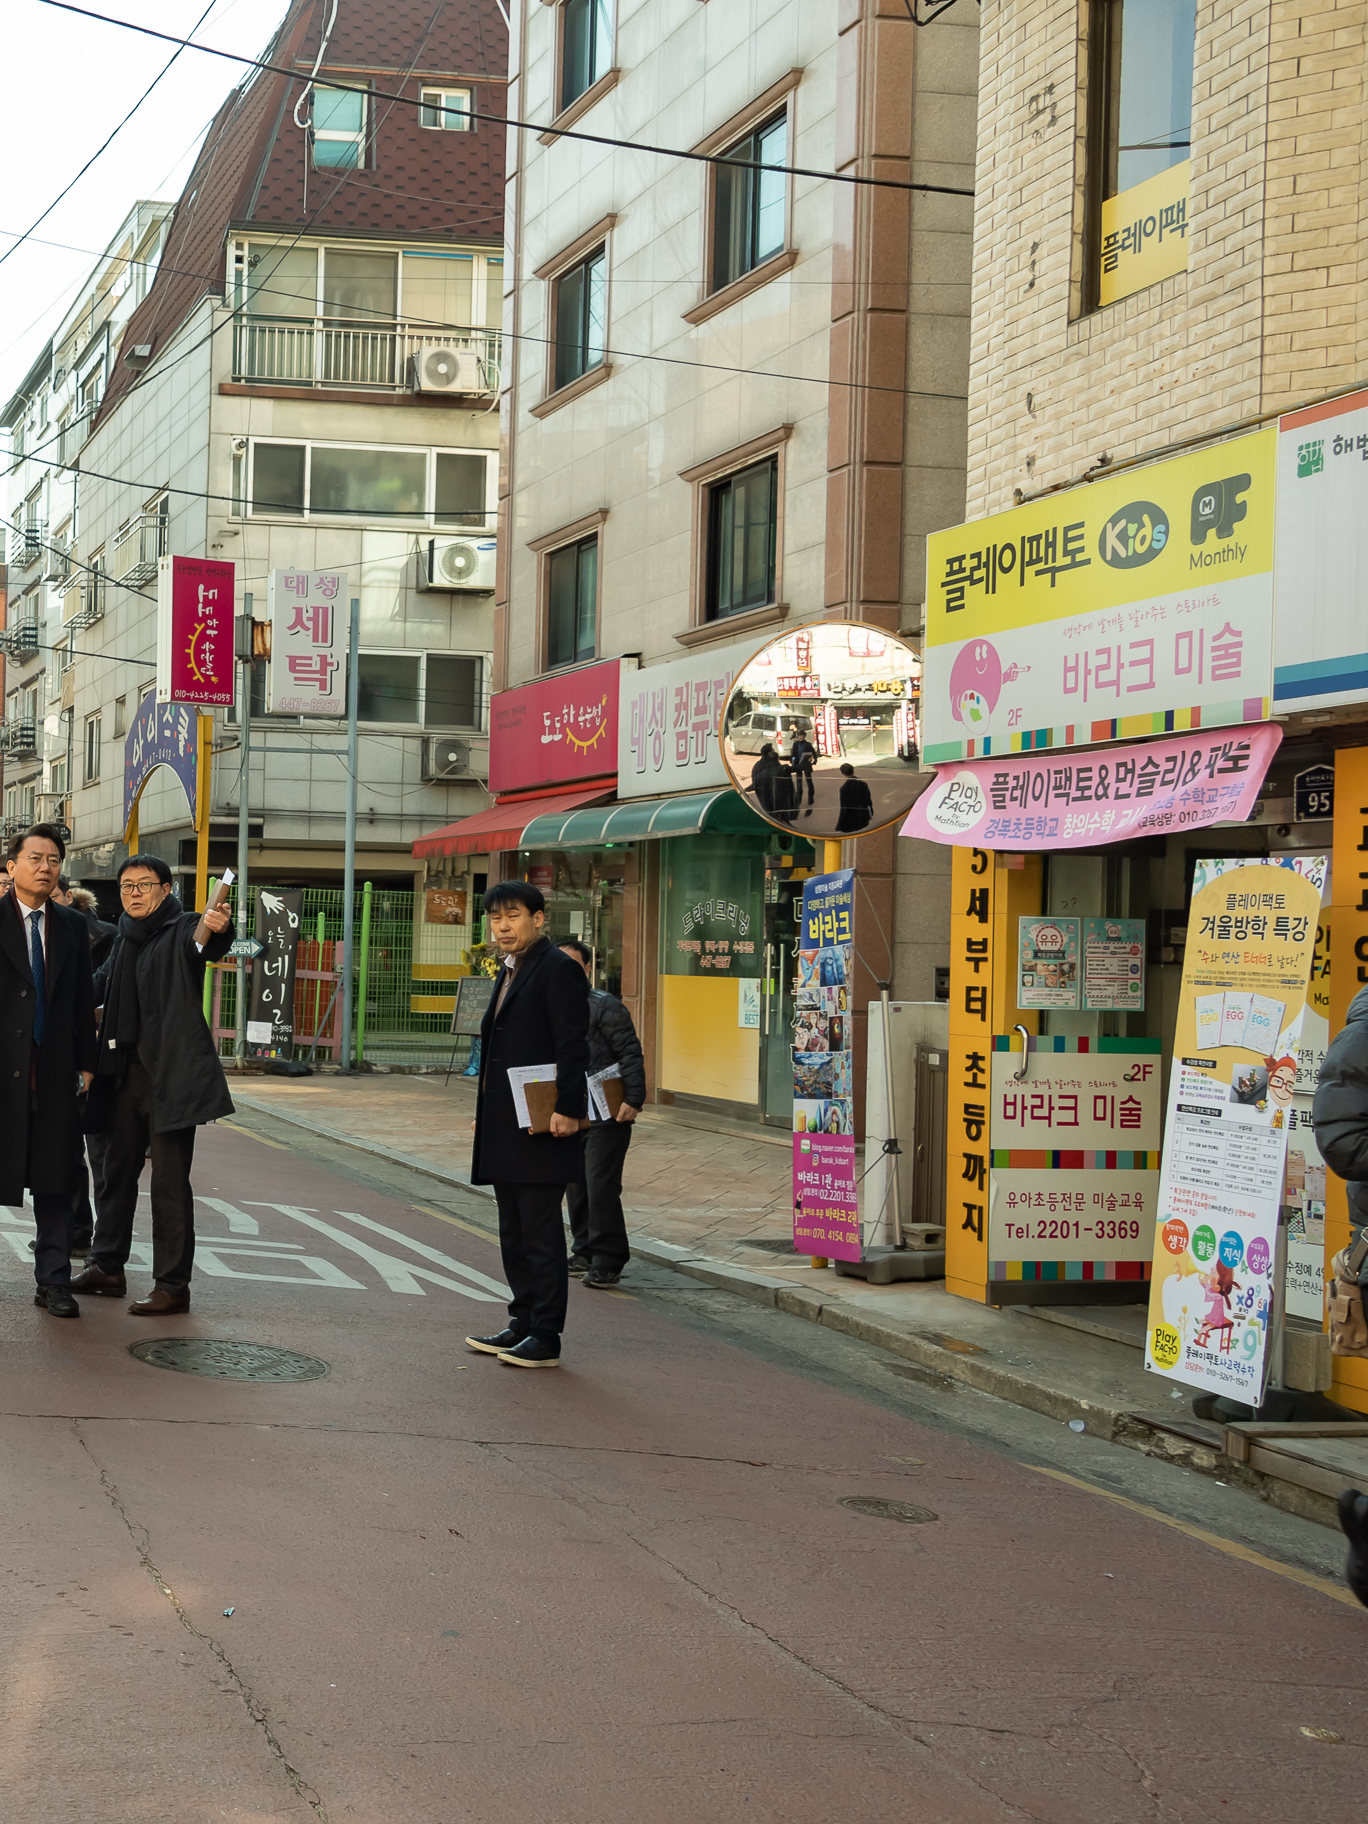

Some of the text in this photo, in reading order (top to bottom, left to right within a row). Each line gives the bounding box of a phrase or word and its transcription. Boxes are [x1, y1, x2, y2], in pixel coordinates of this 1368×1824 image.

[940, 520, 1092, 614] 플레이팩토
[1104, 512, 1167, 562] Kids
[1189, 541, 1248, 571] Monthly
[283, 574, 340, 600] 대성
[1063, 622, 1093, 639] 생각에
[1128, 605, 1167, 628] 달아주는
[1175, 594, 1221, 614] 스토리아트
[286, 604, 340, 696] 세탁
[1063, 621, 1243, 703] 바라크 미술
[279, 697, 340, 713] 447-8267
[541, 704, 575, 744] 도도하
[578, 703, 602, 729] 속눈썹
[1007, 709, 1023, 727] 2F
[946, 781, 979, 801] Play
[938, 796, 982, 815] FACTO
[1308, 792, 1330, 813] 95
[983, 816, 1060, 841] 경복초등학교
[1062, 805, 1116, 839] 창의수학
[1226, 893, 1286, 911] 플레이팩토
[808, 909, 851, 947] 바라크
[1199, 915, 1309, 942] 겨울방학 특강
[1222, 951, 1241, 964] 연산
[1200, 1013, 1219, 1024] EGG
[1226, 1010, 1244, 1021] EGG
[1251, 1014, 1270, 1027] EGG
[1131, 1064, 1153, 1081] 2F
[1003, 1094, 1142, 1129] 바라크 미술
[962, 1050, 987, 1243] 초등까지
[797, 1171, 819, 1185] 바라크
[1005, 1190, 1145, 1213] 유아초등전문 미술교육
[825, 1206, 847, 1222] 바라크
[1004, 1219, 1140, 1240] Tel.2201-3369
[1167, 1234, 1187, 1252] 생각
[1197, 1240, 1214, 1258] 활동
[1223, 1247, 1241, 1264] 지식
[1252, 1254, 1268, 1271] 상상
[1155, 1328, 1177, 1346] Play
[1154, 1340, 1178, 1355] FACTO
